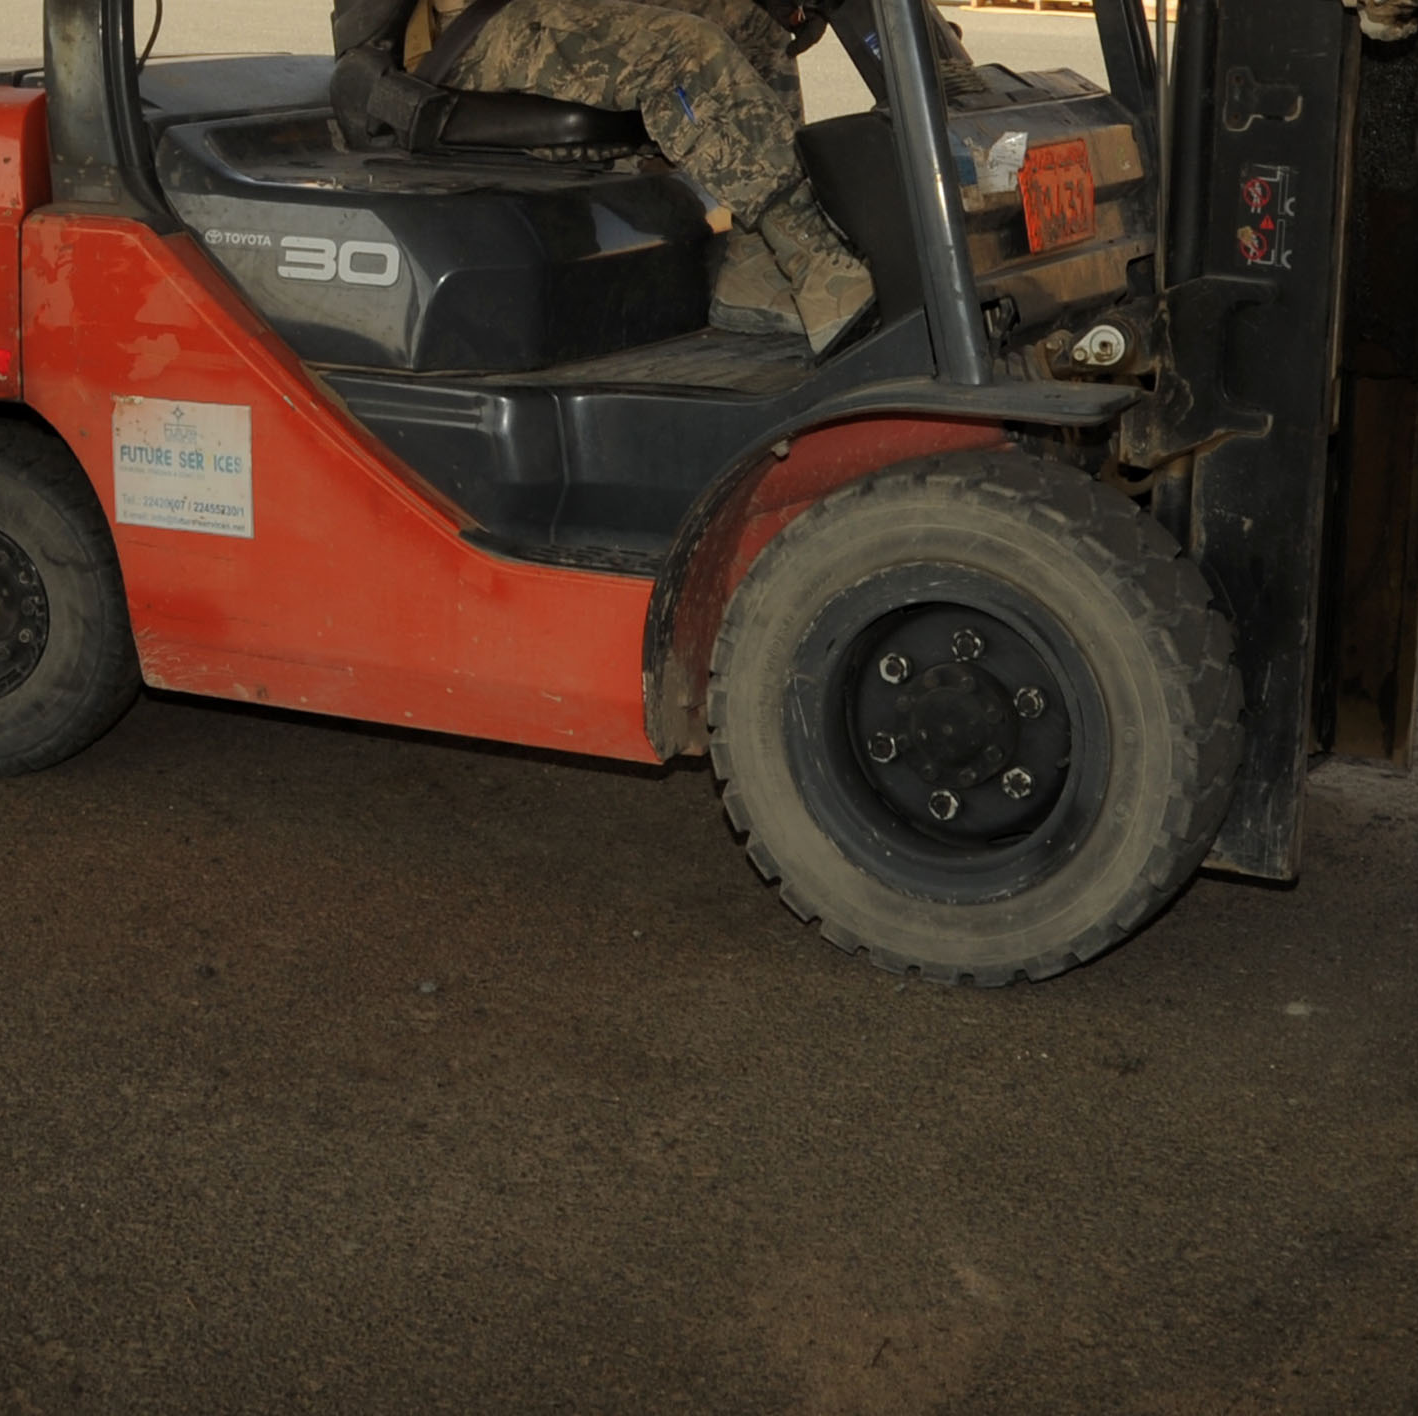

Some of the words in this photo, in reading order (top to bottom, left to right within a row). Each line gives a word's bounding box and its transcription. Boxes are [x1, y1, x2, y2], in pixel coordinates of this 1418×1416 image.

[223, 232, 272, 247] TOYOTA
[277, 235, 401, 288] 30
[120, 445, 173, 467] FUTURE
[179, 450, 243, 474] SERICES
